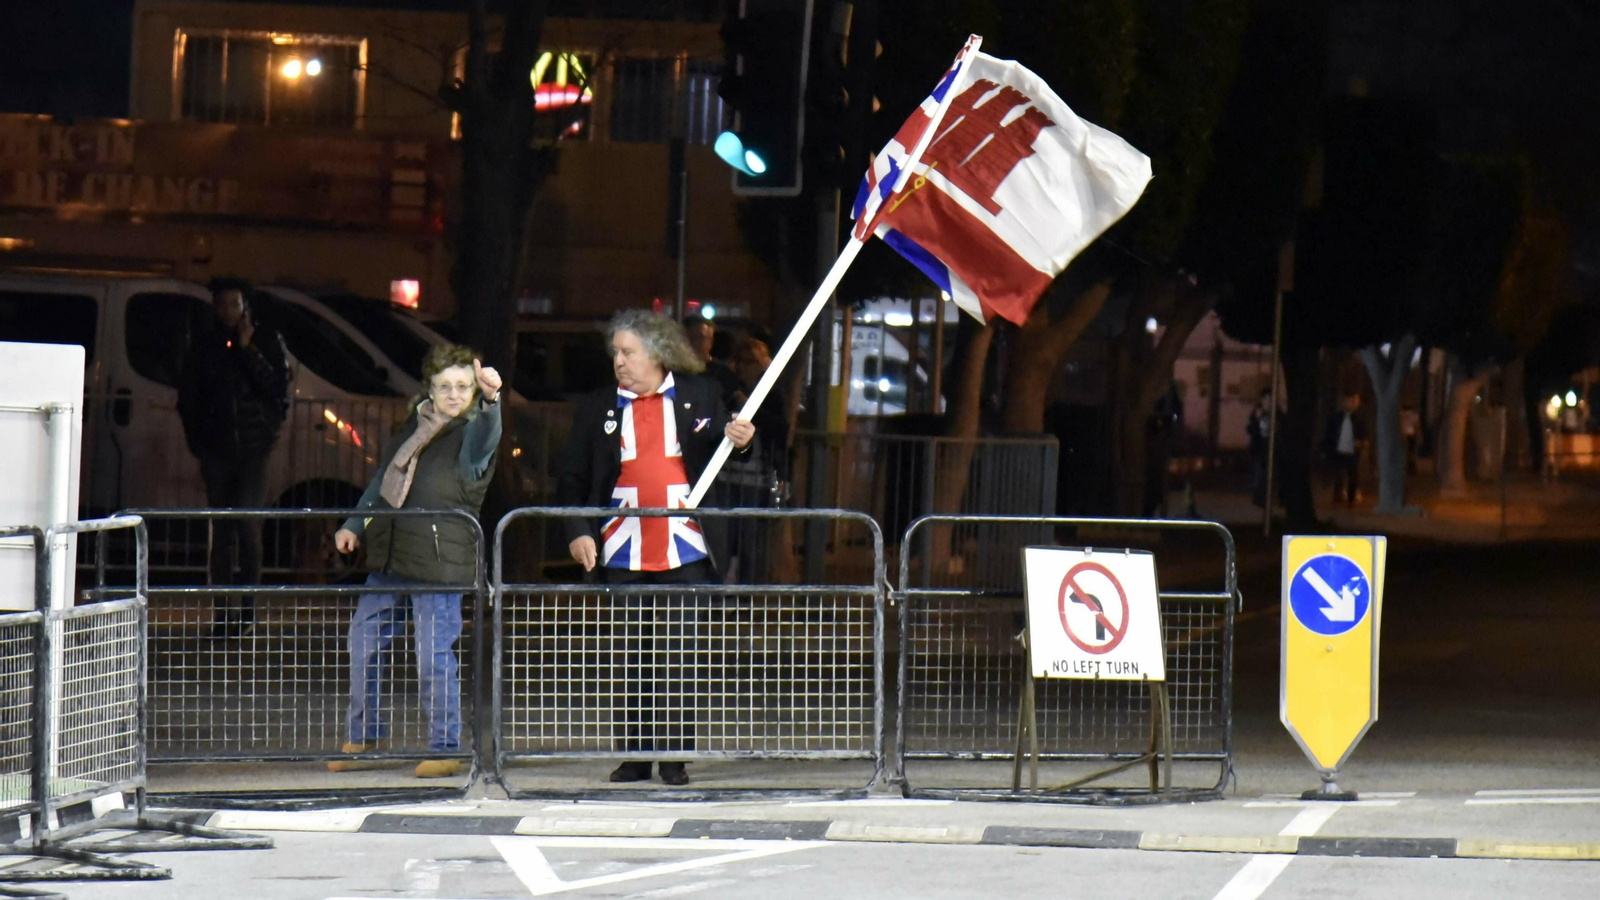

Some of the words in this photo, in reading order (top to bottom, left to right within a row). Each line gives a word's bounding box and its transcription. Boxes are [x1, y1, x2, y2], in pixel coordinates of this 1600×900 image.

[82, 173, 239, 212] CHANGE
[1052, 659, 1069, 673] NO
[1073, 660, 1101, 674] LEFT
[1106, 661, 1140, 675] TURN
